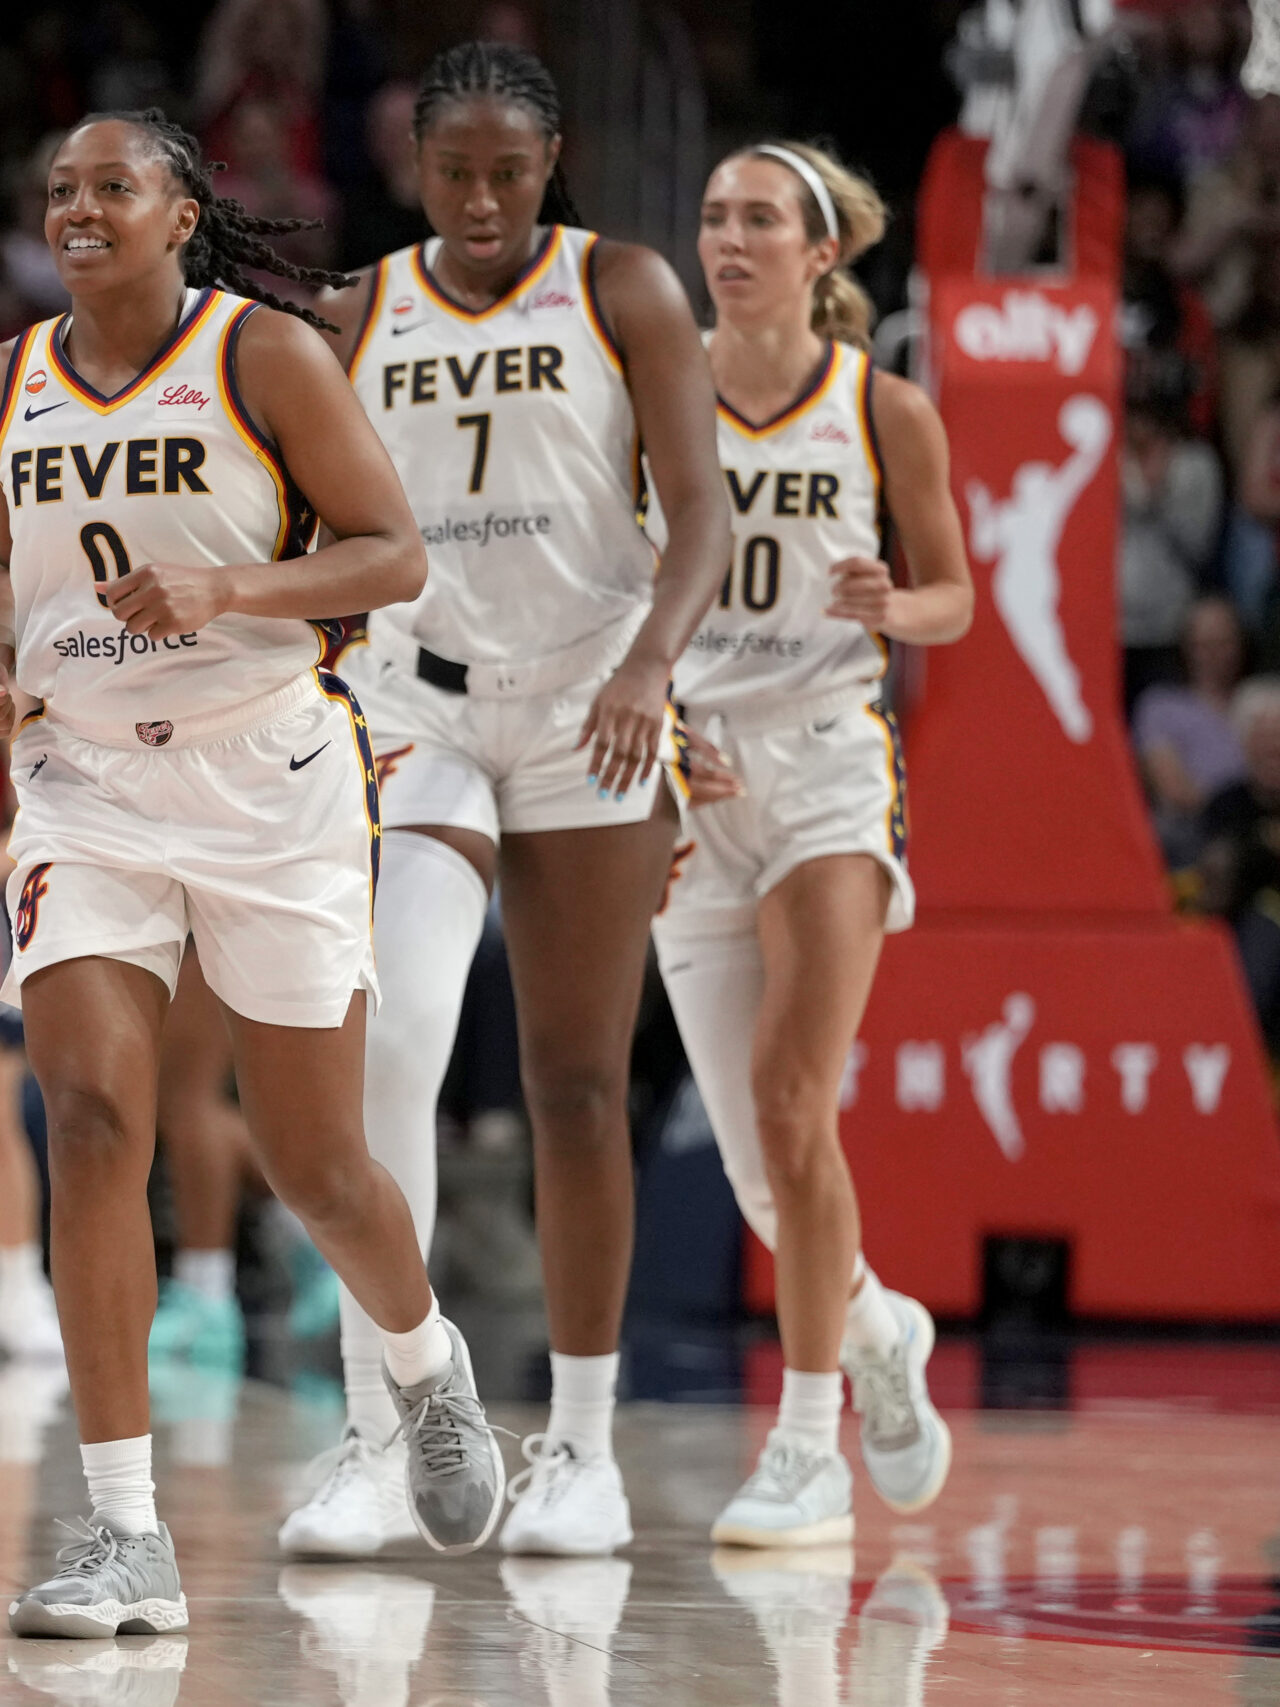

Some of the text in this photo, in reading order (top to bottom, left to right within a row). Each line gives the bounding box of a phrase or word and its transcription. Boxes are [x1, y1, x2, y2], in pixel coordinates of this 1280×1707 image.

[157, 384, 211, 411] Lilly
[383, 344, 568, 410] FEVER
[10, 436, 214, 509] FEVER
[455, 411, 491, 495] 7
[721, 468, 840, 520] VER
[420, 511, 551, 548] salesforce
